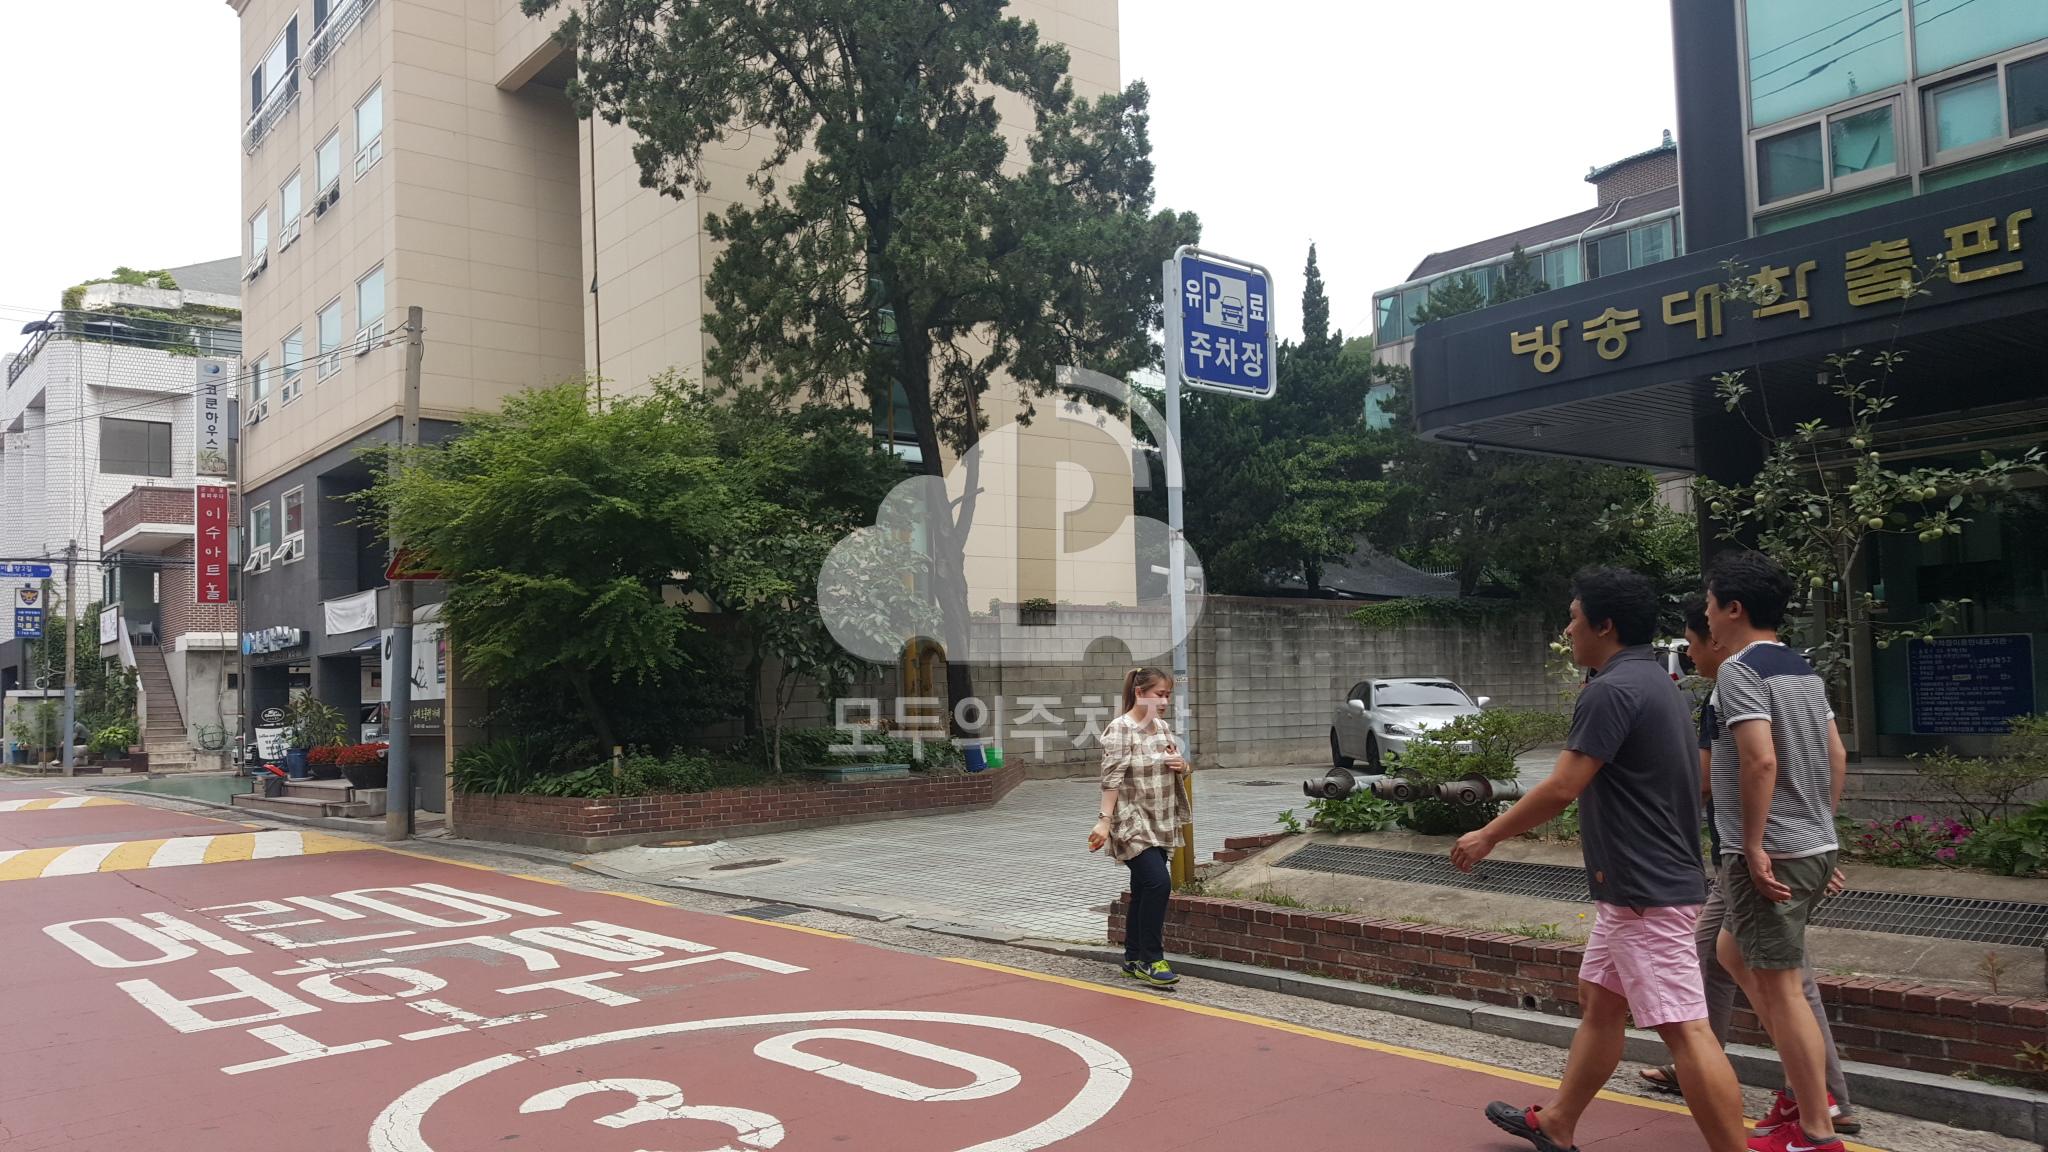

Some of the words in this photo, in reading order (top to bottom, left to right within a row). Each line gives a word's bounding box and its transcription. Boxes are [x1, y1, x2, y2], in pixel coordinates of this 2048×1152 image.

[1190, 330, 1264, 378] 주차장
[205, 384, 220, 450] 코쿤하우스
[42, 883, 562, 969] 어린이
[117, 920, 809, 1075] 보호구역
